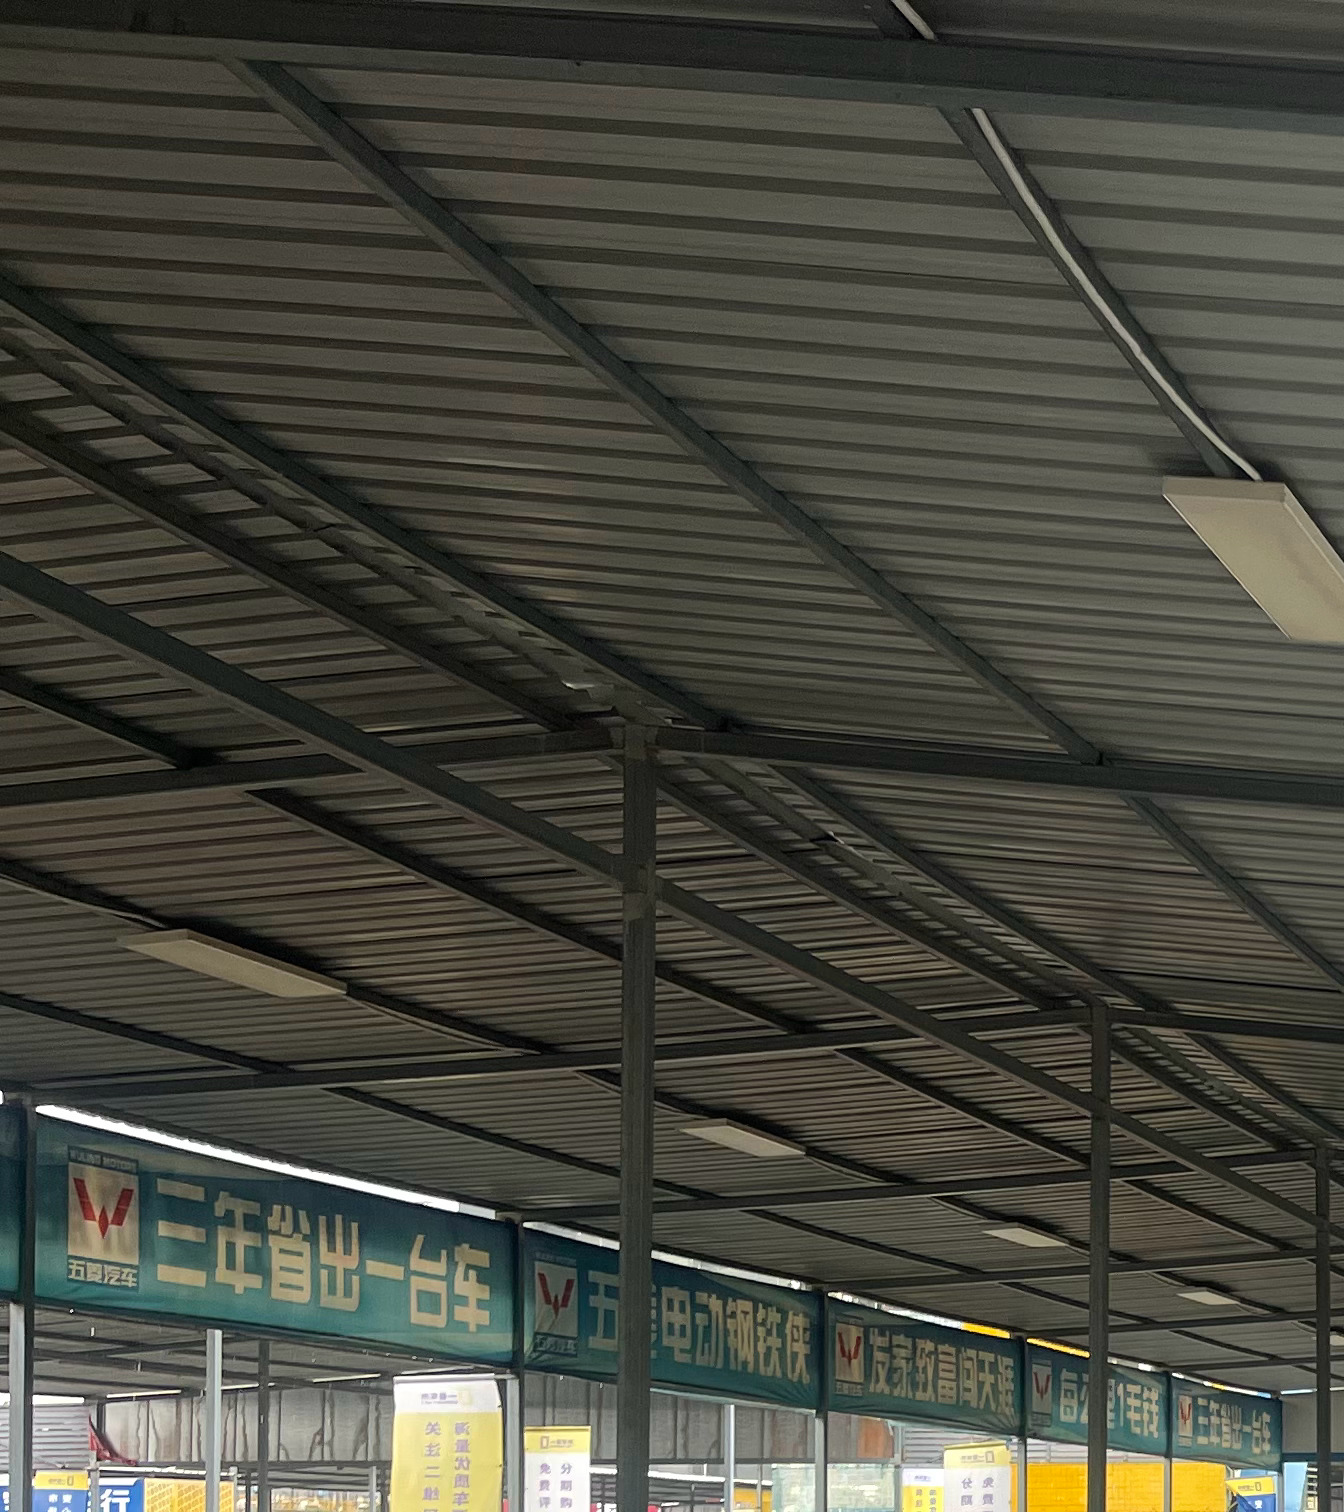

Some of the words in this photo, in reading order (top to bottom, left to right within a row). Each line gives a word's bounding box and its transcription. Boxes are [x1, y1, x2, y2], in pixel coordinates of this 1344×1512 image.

[157, 1177, 490, 1333] 三年省出一台车
[588, 1270, 811, 1384] 五电动钢铁侠
[1197, 1396, 1272, 1455] 三年省出一台车
